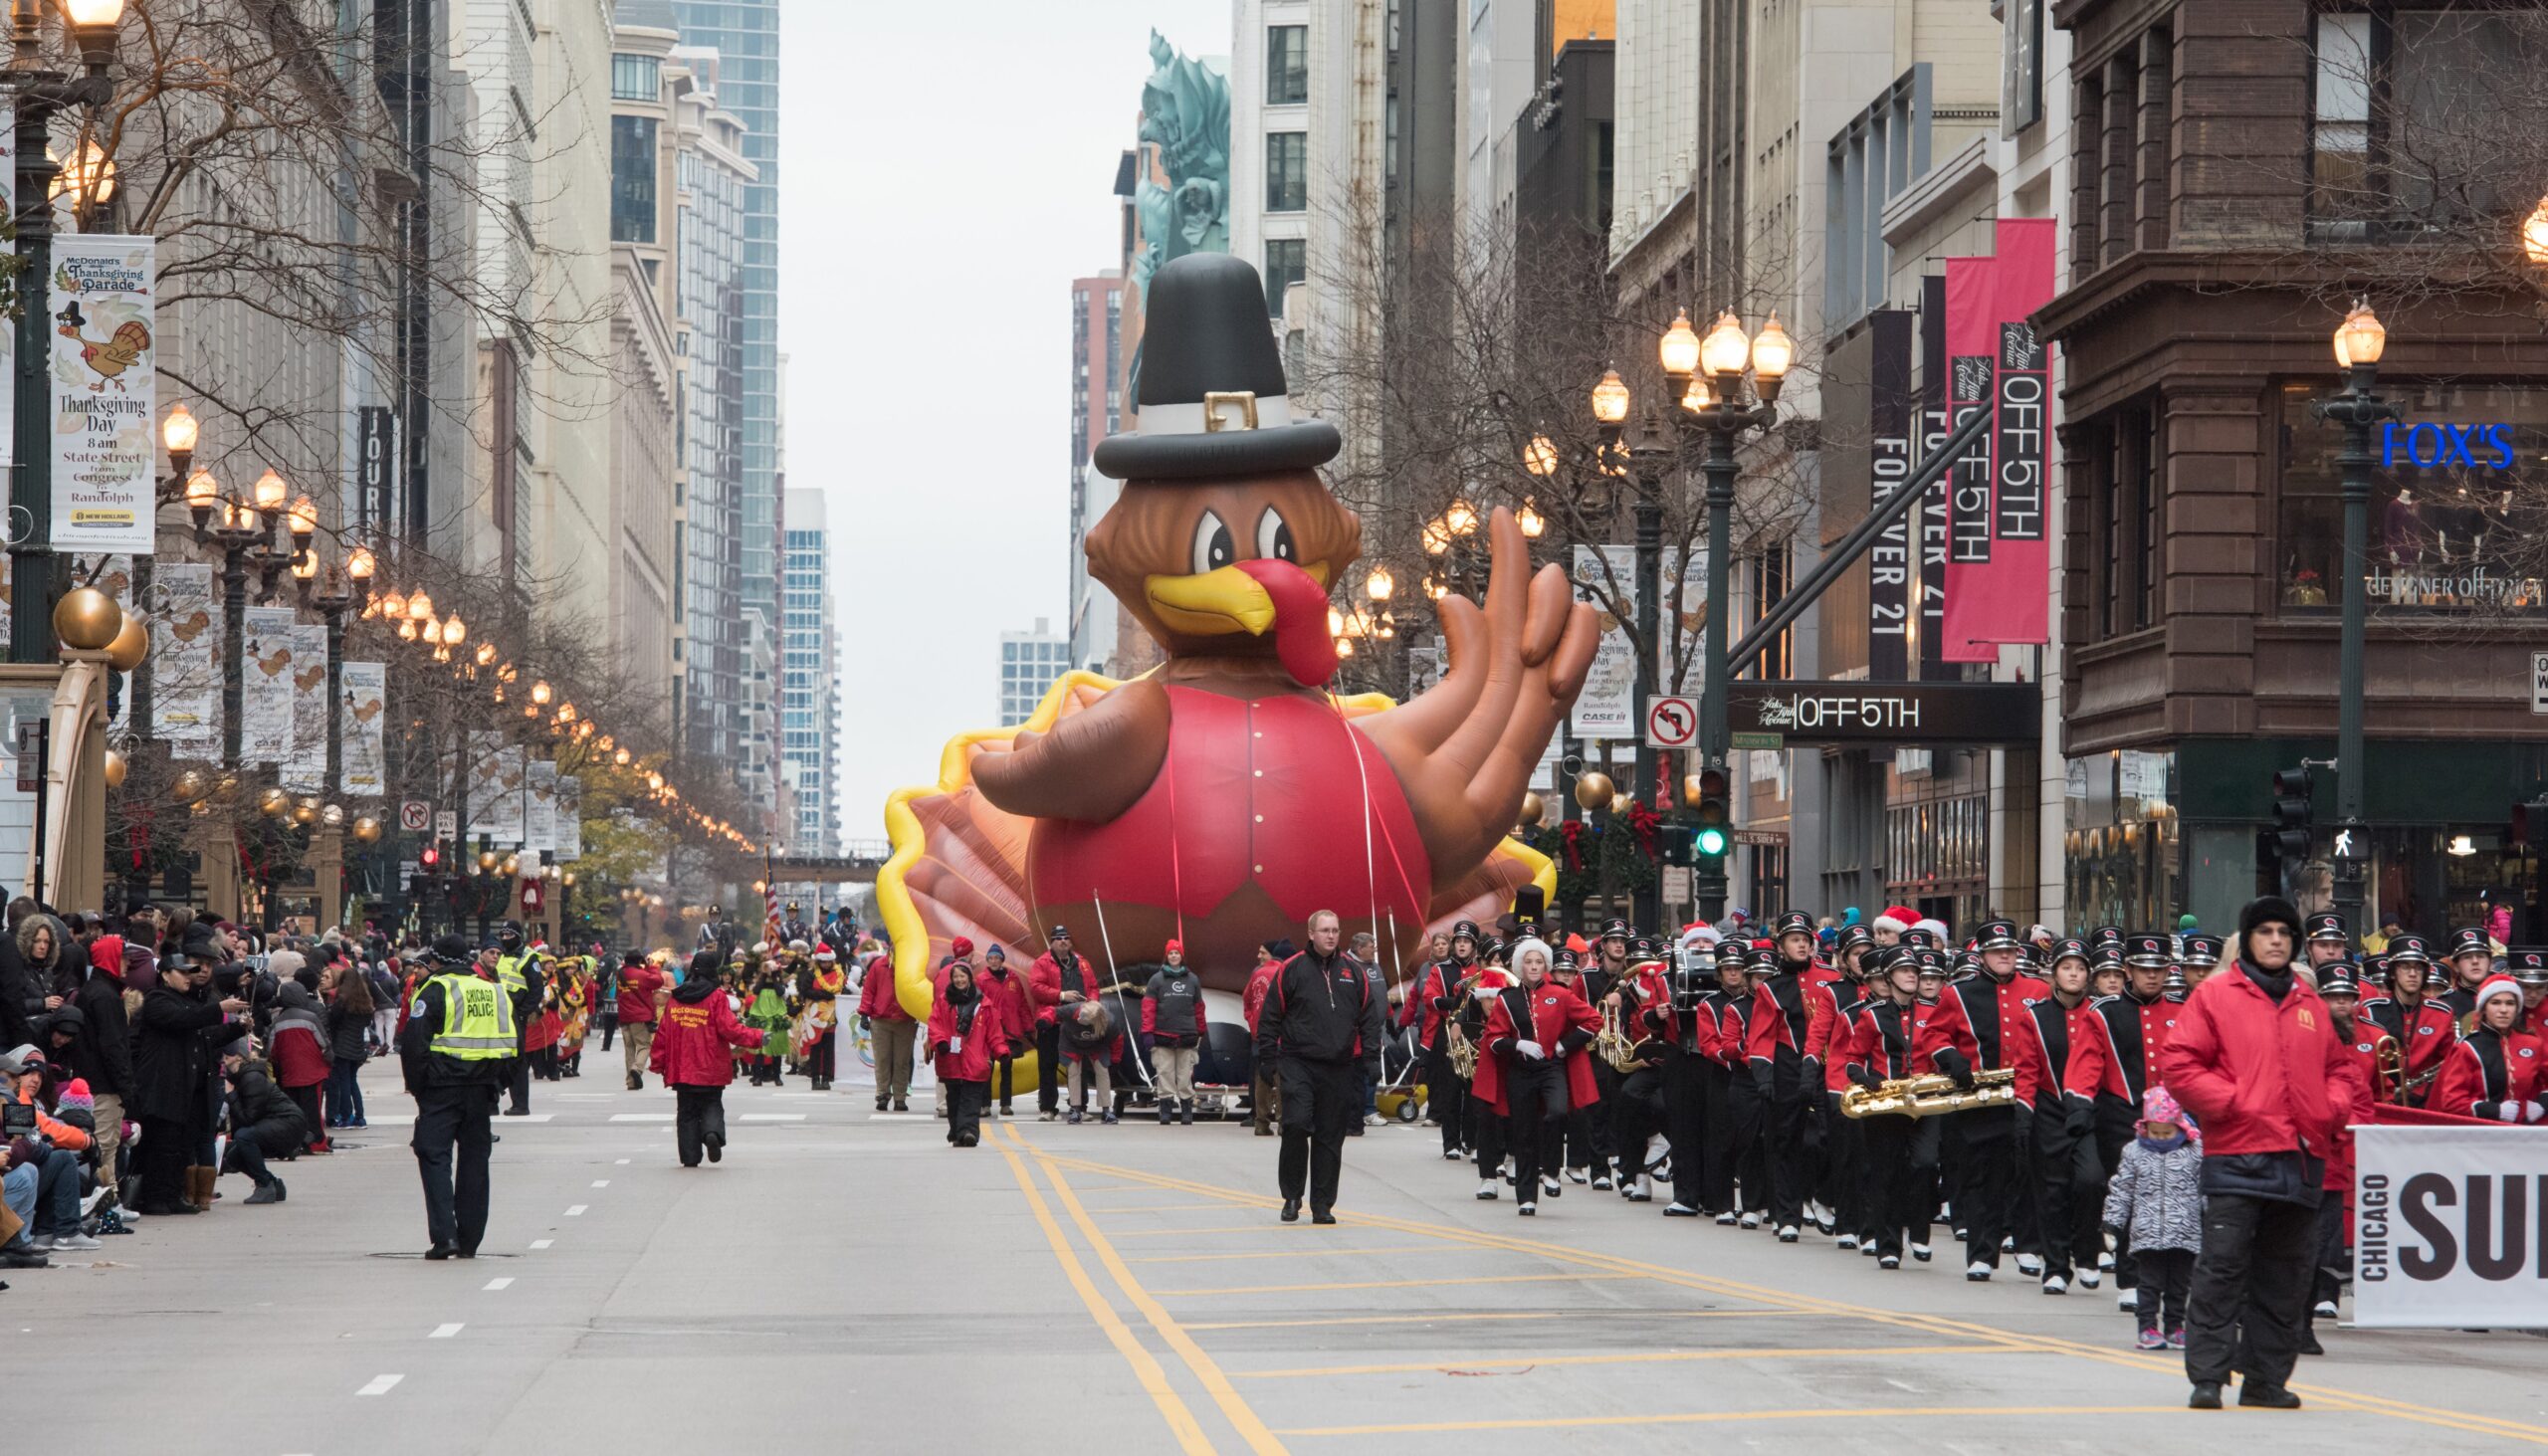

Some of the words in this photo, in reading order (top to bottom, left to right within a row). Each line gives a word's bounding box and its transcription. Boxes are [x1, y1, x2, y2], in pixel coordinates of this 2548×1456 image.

[68, 265, 144, 281] Thanksgiving
[82, 279, 135, 293] Parade
[60, 394, 146, 418] Thanksgiving
[2004, 376, 2042, 454] OFF
[87, 414, 116, 436] Day
[88, 437, 96, 449] 8
[98, 439, 118, 449] am
[2382, 422, 2515, 470] FOX'S
[63, 451, 99, 463] State
[102, 451, 141, 464] Street
[73, 473, 132, 484] Congress
[71, 492, 134, 506] Randolph
[2001, 459, 2040, 536] 5TH
[1872, 438, 1908, 585] FORVER
[1954, 487, 1990, 560] 5TH
[1871, 603, 1906, 634] 21
[1799, 697, 1857, 727] OFF
[1860, 697, 1919, 728] 5TH
[2361, 1173, 2390, 1282] CHICAGO
